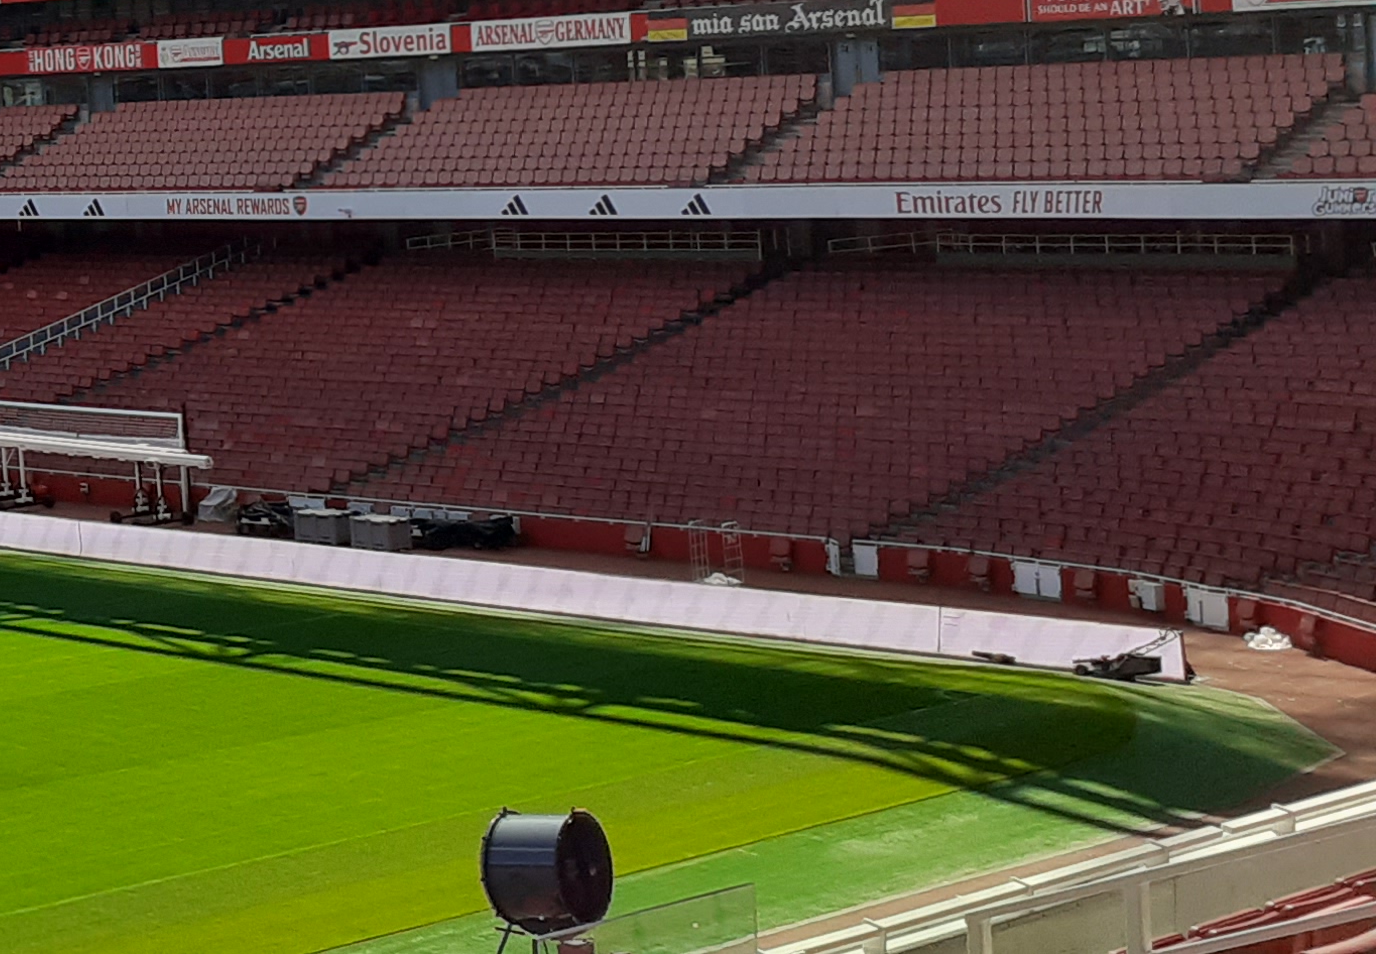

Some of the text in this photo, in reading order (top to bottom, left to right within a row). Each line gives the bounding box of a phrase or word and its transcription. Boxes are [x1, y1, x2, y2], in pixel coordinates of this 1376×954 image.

[1037, 4, 1077, 15] SHOULD
[476, 18, 625, 46] ARSENAL GERMANY
[692, 13, 734, 35] mia
[248, 38, 310, 60] Arsenal
[359, 28, 447, 55] Slovenia
[35, 48, 76, 72] HONG
[93, 44, 135, 69] KONG
[167, 199, 290, 215] MY ARSENAL REWARDS
[896, 191, 1102, 214] Emirates FLY BETTER
